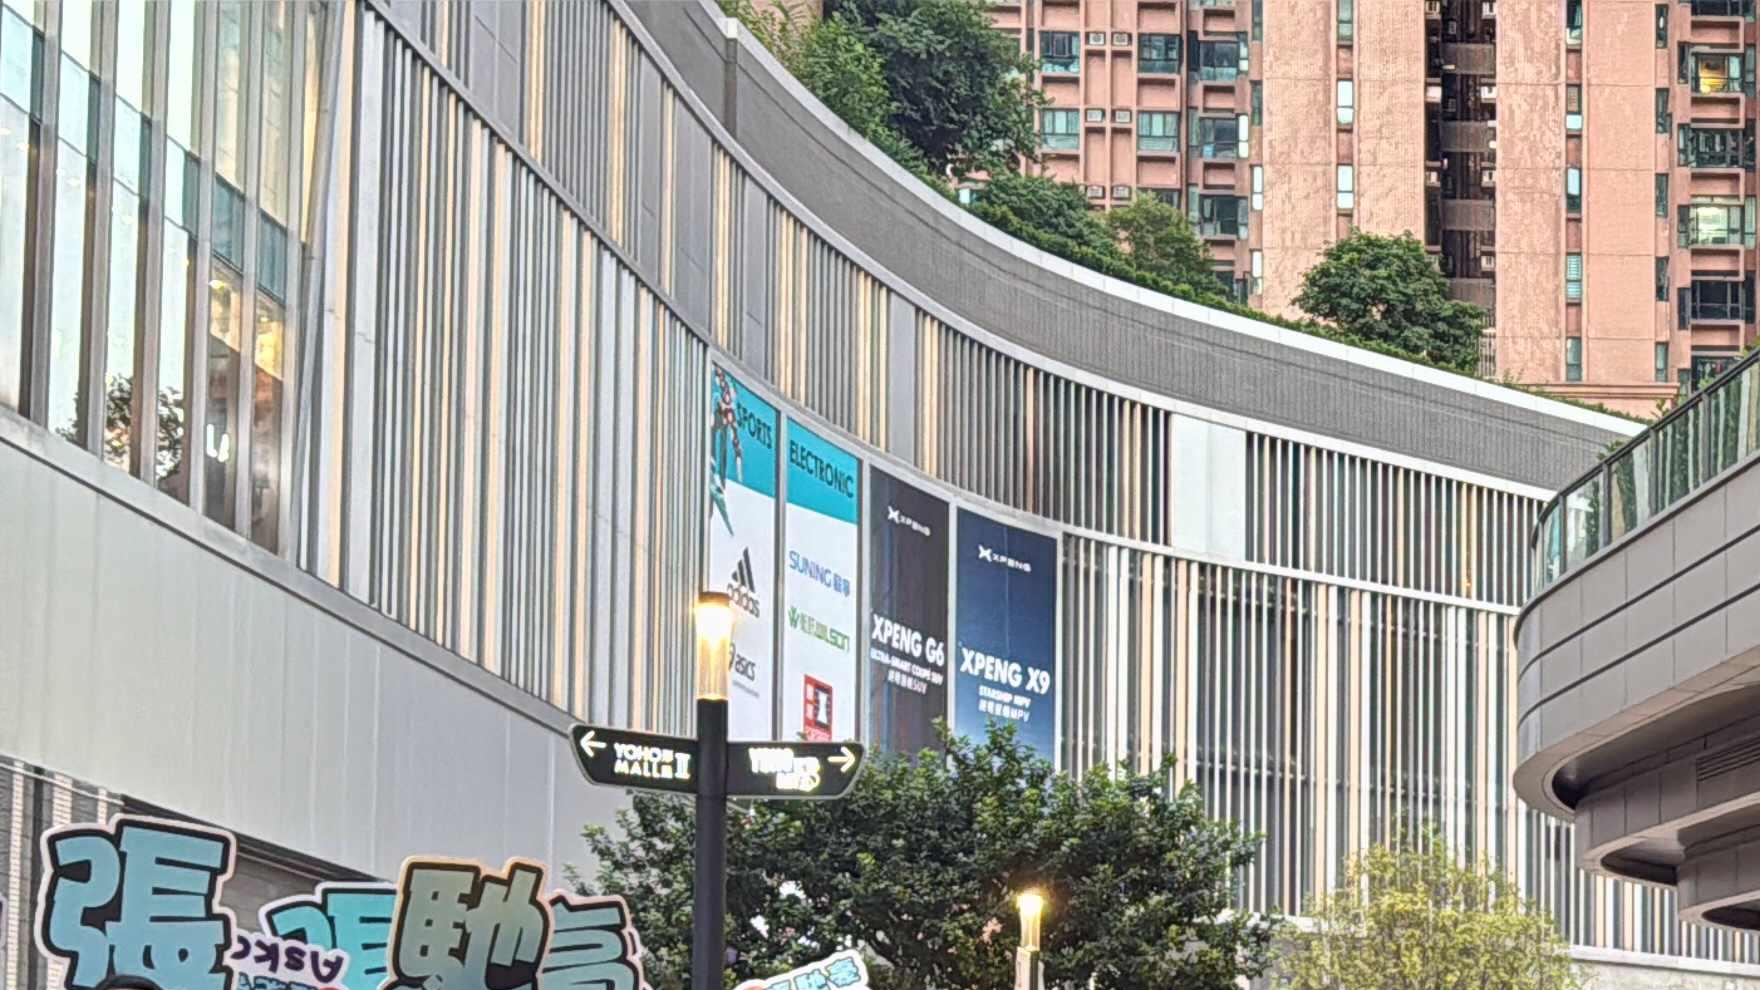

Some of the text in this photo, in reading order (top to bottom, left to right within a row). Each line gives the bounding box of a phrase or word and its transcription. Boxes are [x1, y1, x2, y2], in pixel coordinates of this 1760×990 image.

[736, 401, 773, 449] SPORTS
[789, 440, 854, 498] ELECTRONIC
[789, 550, 832, 588] SUNING
[871, 613, 945, 666] XPENG G6
[735, 653, 757, 682] asics
[960, 646, 1023, 688] XPENG
[1025, 666, 1050, 695] X9
